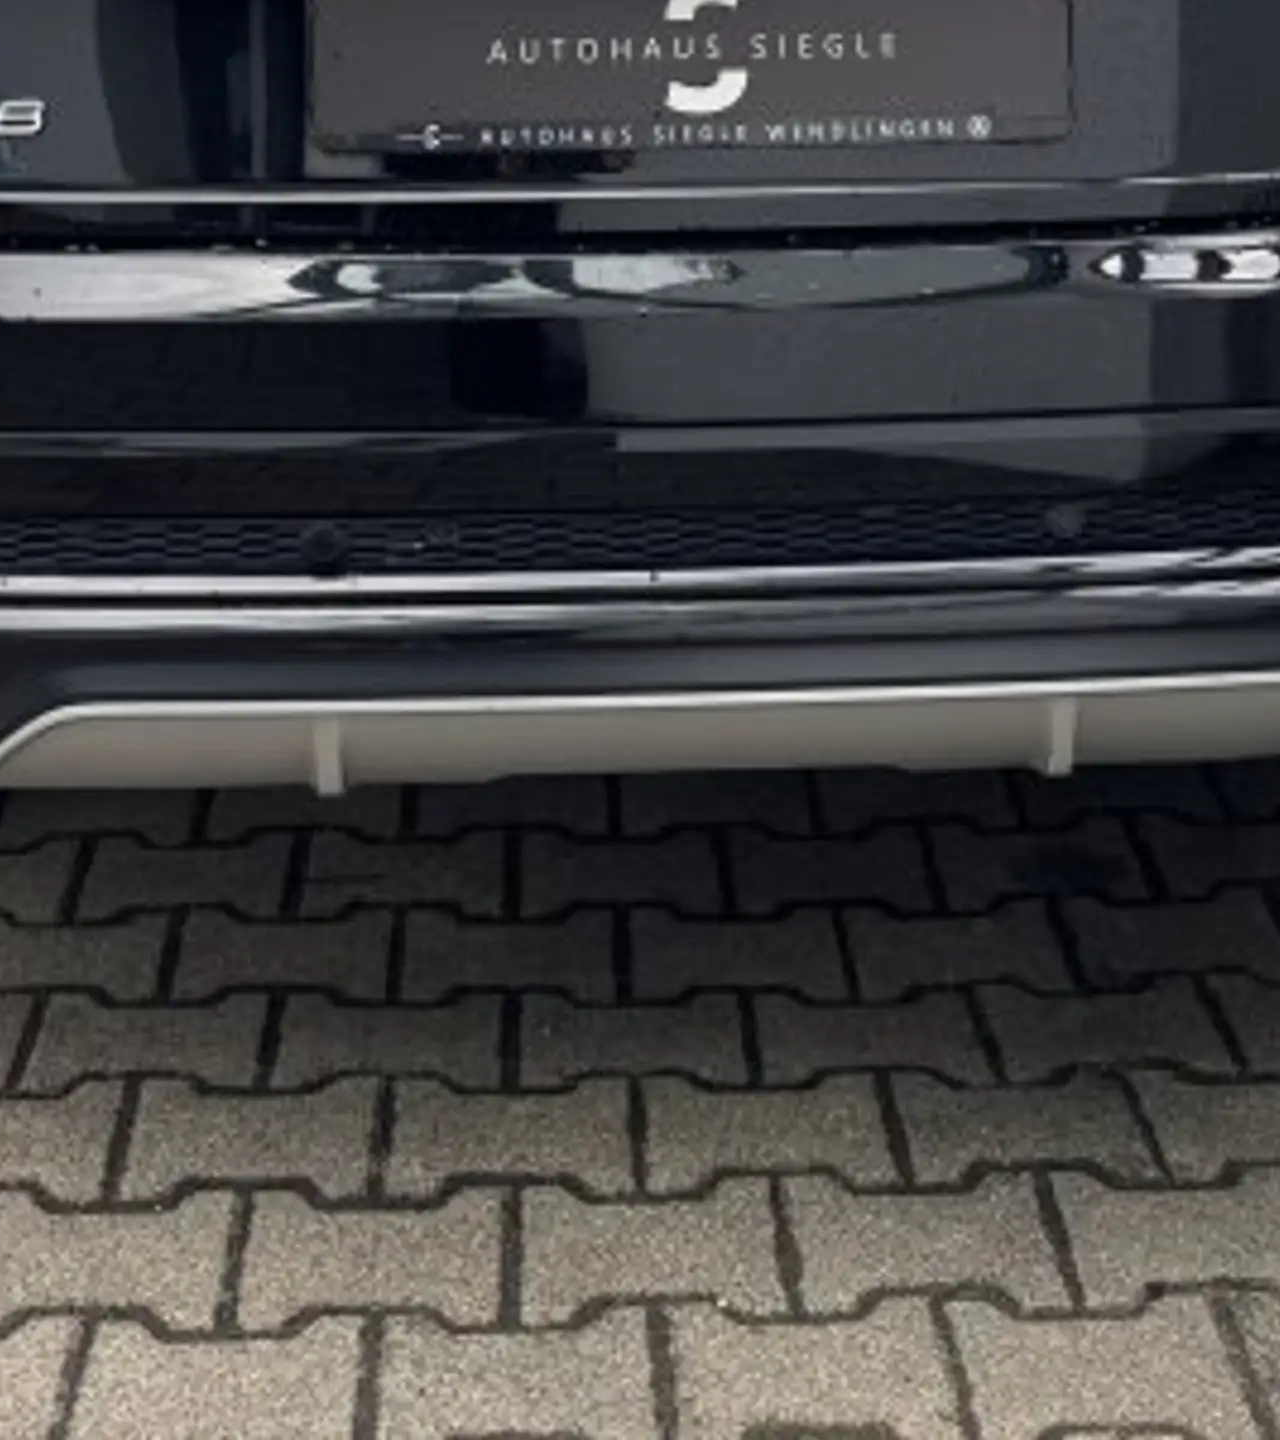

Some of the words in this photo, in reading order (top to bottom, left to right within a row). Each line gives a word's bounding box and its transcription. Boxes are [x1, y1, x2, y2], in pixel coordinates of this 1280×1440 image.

[486, 32, 720, 65] AUTOHAUS
[749, 32, 898, 60] SIEGLE
[479, 123, 633, 147] AUTOHAUS
[653, 122, 749, 144] SIEGLE
[765, 118, 954, 143] WENDLINGEN
